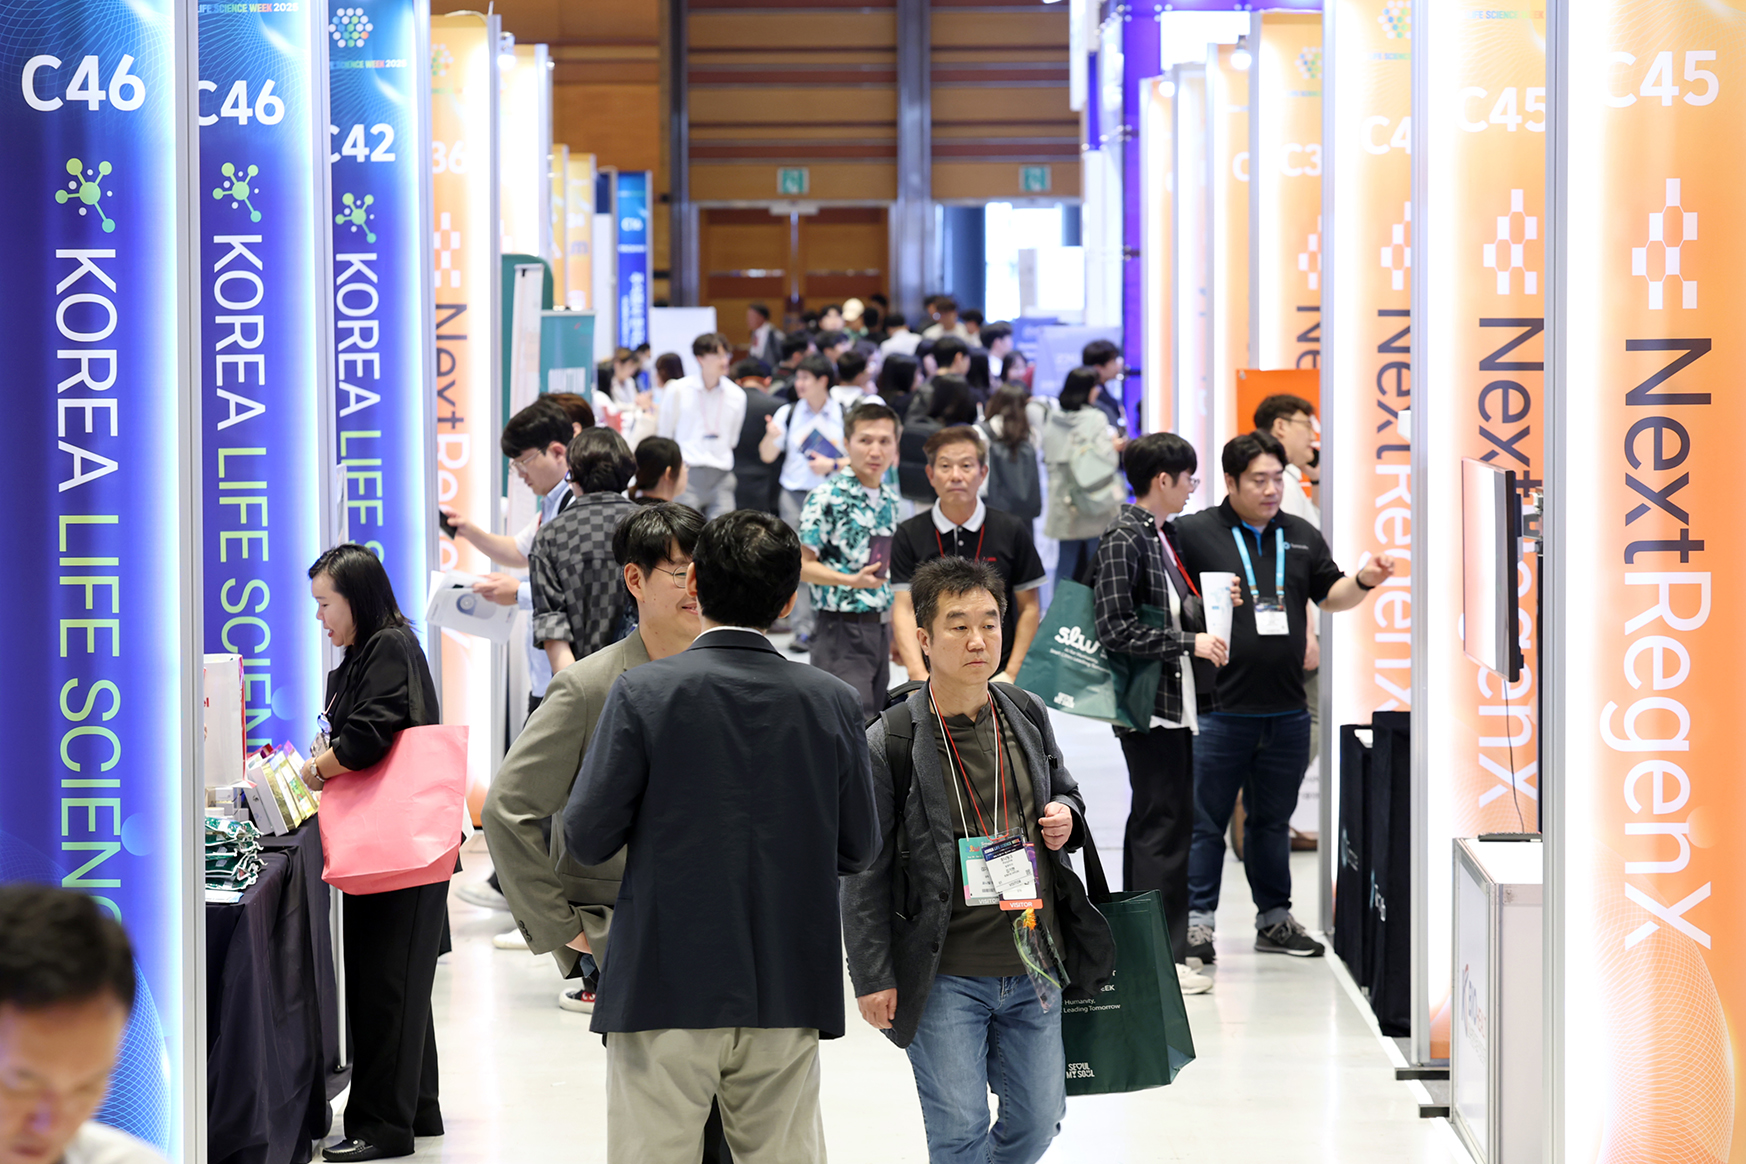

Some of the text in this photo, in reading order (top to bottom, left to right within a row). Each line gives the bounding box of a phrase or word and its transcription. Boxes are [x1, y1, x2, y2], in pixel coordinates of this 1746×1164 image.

[249, 4, 273, 13] WEEK
[273, 2, 299, 12] 2025
[20, 53, 146, 112] C46
[199, 79, 285, 126] C46
[1458, 86, 1546, 133] C45
[1600, 49, 1720, 108] C45
[55, 248, 119, 493] KOREA
[213, 235, 266, 430] KOREA
[335, 253, 382, 418] KOREA
[218, 447, 269, 563] LIFE
[340, 430, 384, 527] LIFE
[59, 515, 120, 658] LIFE
[1600, 338, 1712, 950] NextRegenX
[1063, 1004, 1121, 1014] Leading Tomorrow
[1067, 1063, 1090, 1071] SEOUL
